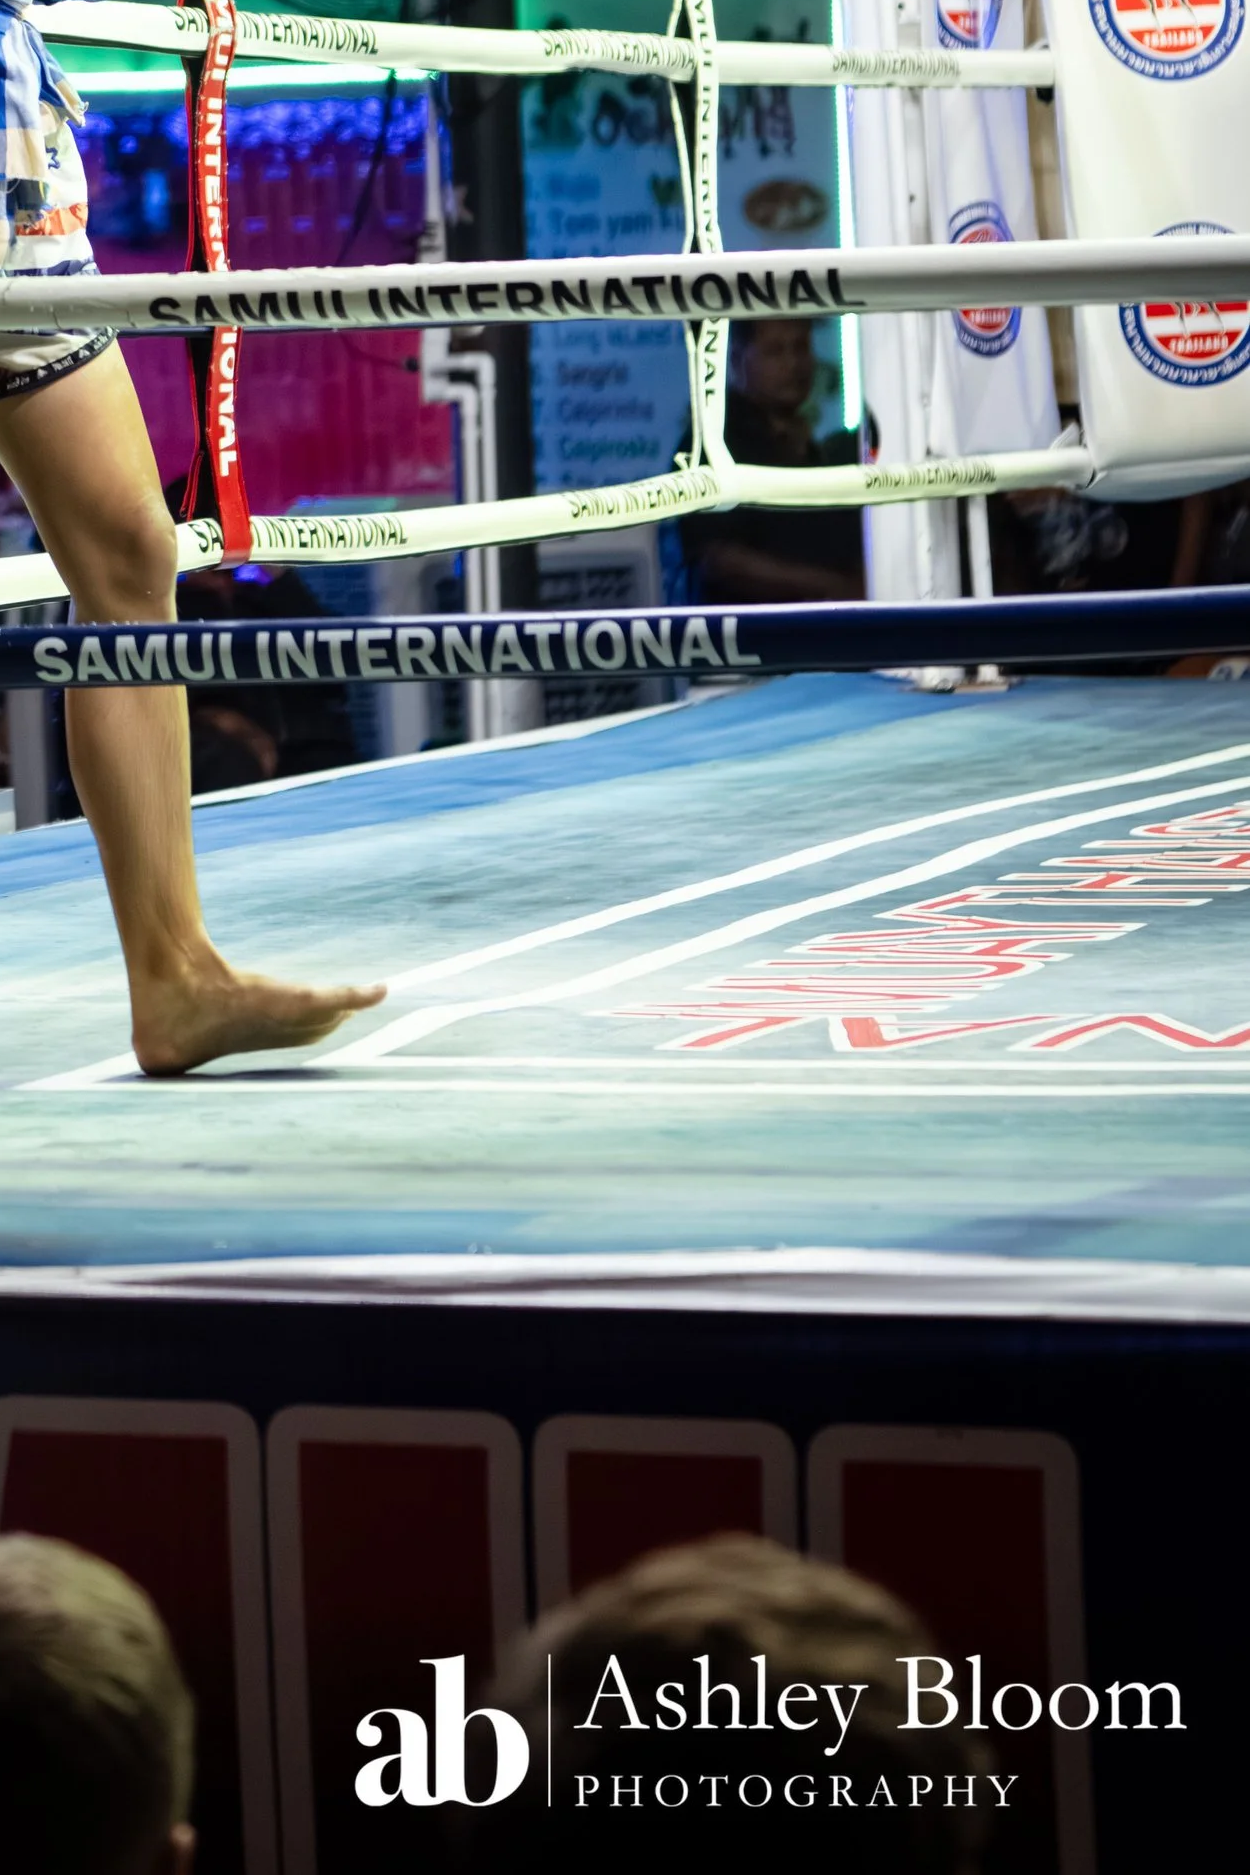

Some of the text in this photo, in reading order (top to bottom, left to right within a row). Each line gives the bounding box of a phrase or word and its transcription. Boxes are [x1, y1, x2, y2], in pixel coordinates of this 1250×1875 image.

[237, 10, 380, 56] INTERNATIONAL
[150, 269, 866, 326] SAMUI INTERNATIONAL
[259, 514, 408, 549] INTERNATIONAL
[34, 616, 762, 683] SAMUI INTERNATIONAL
